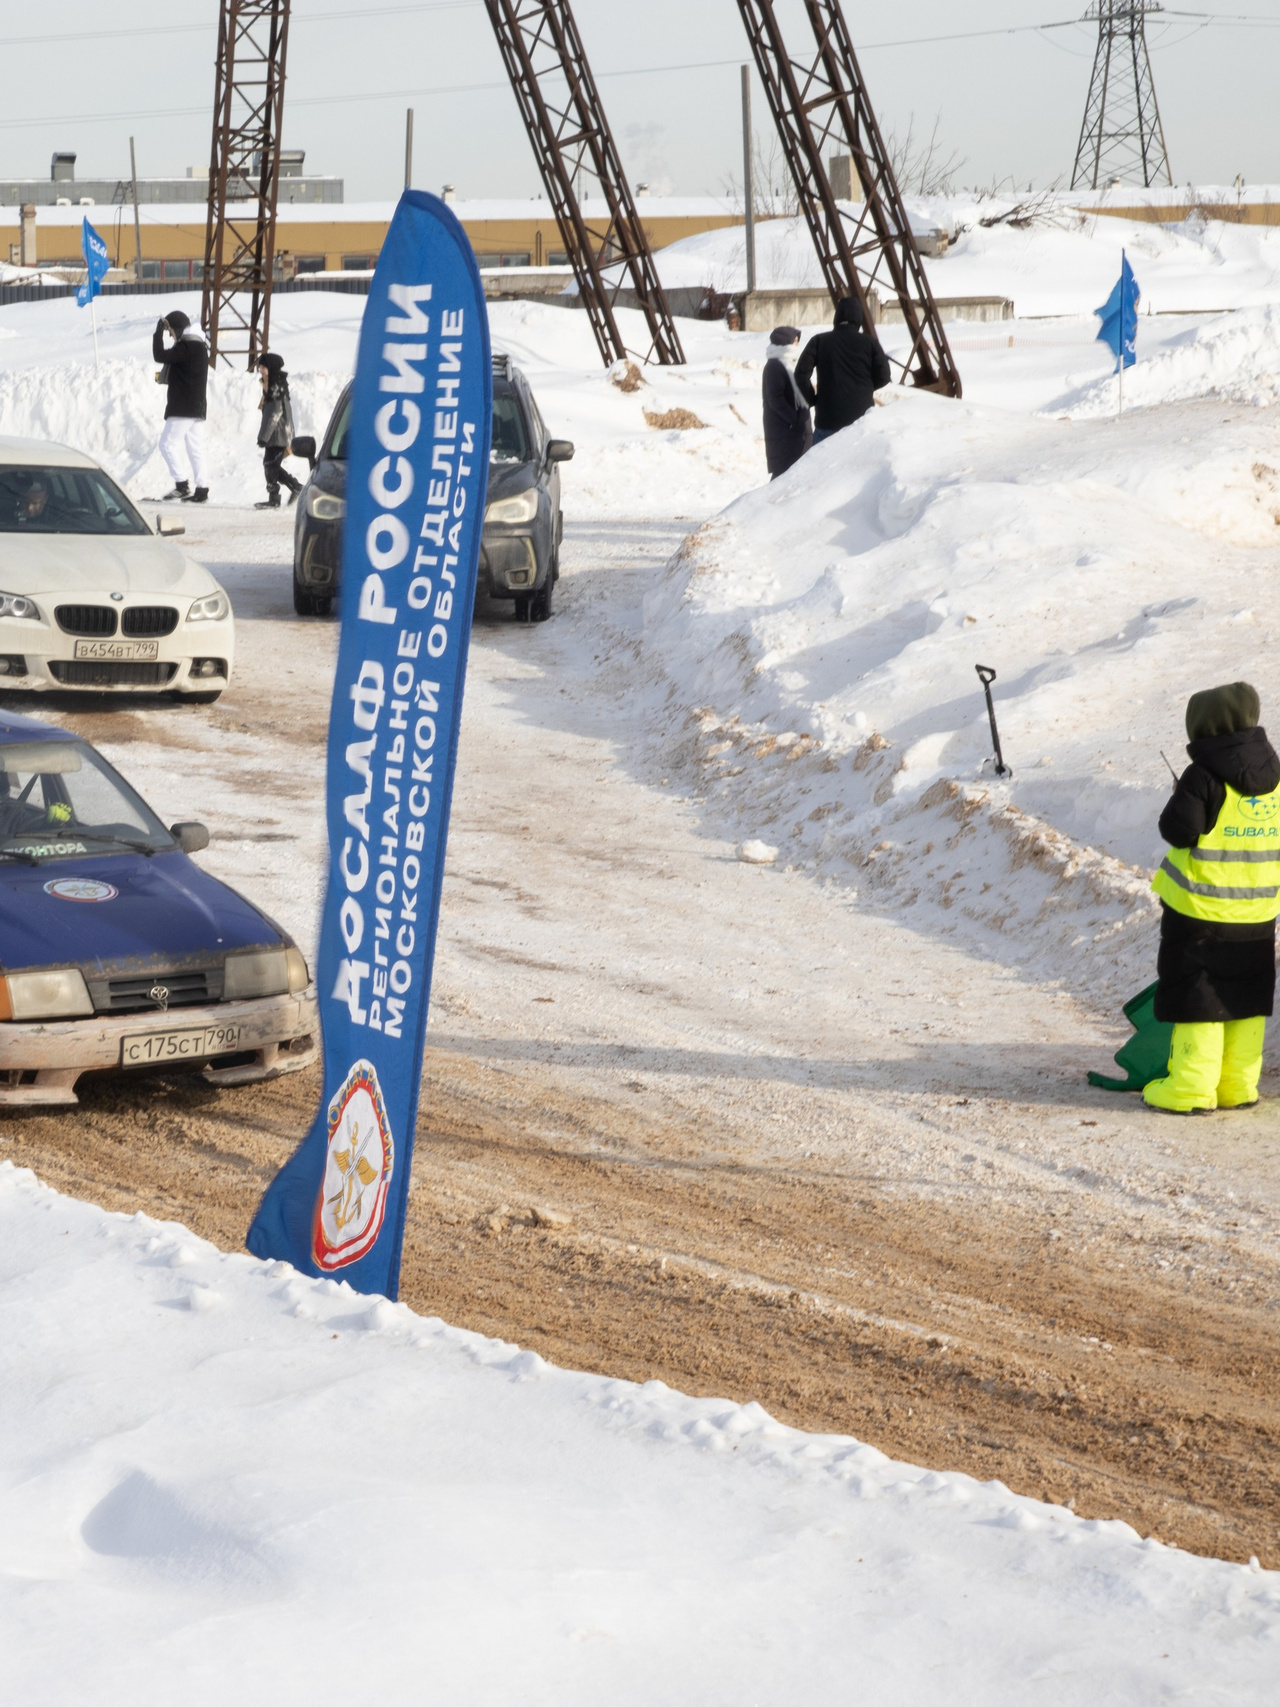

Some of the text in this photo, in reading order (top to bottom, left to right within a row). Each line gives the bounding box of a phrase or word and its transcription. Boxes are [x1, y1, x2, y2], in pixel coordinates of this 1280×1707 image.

[80, 643, 155, 658] В454ВТ 799
[330, 283, 433, 1026] ДОСААФ РОССИИ
[369, 308, 464, 1032] РЕГИОНАЛЬНОЕ ОТДЕЛЕНИЕ
[384, 422, 476, 1039] МОСКОВСКОЙ ОБЛАСТИ
[128, 1028, 235, 1060] С175СТ 790
